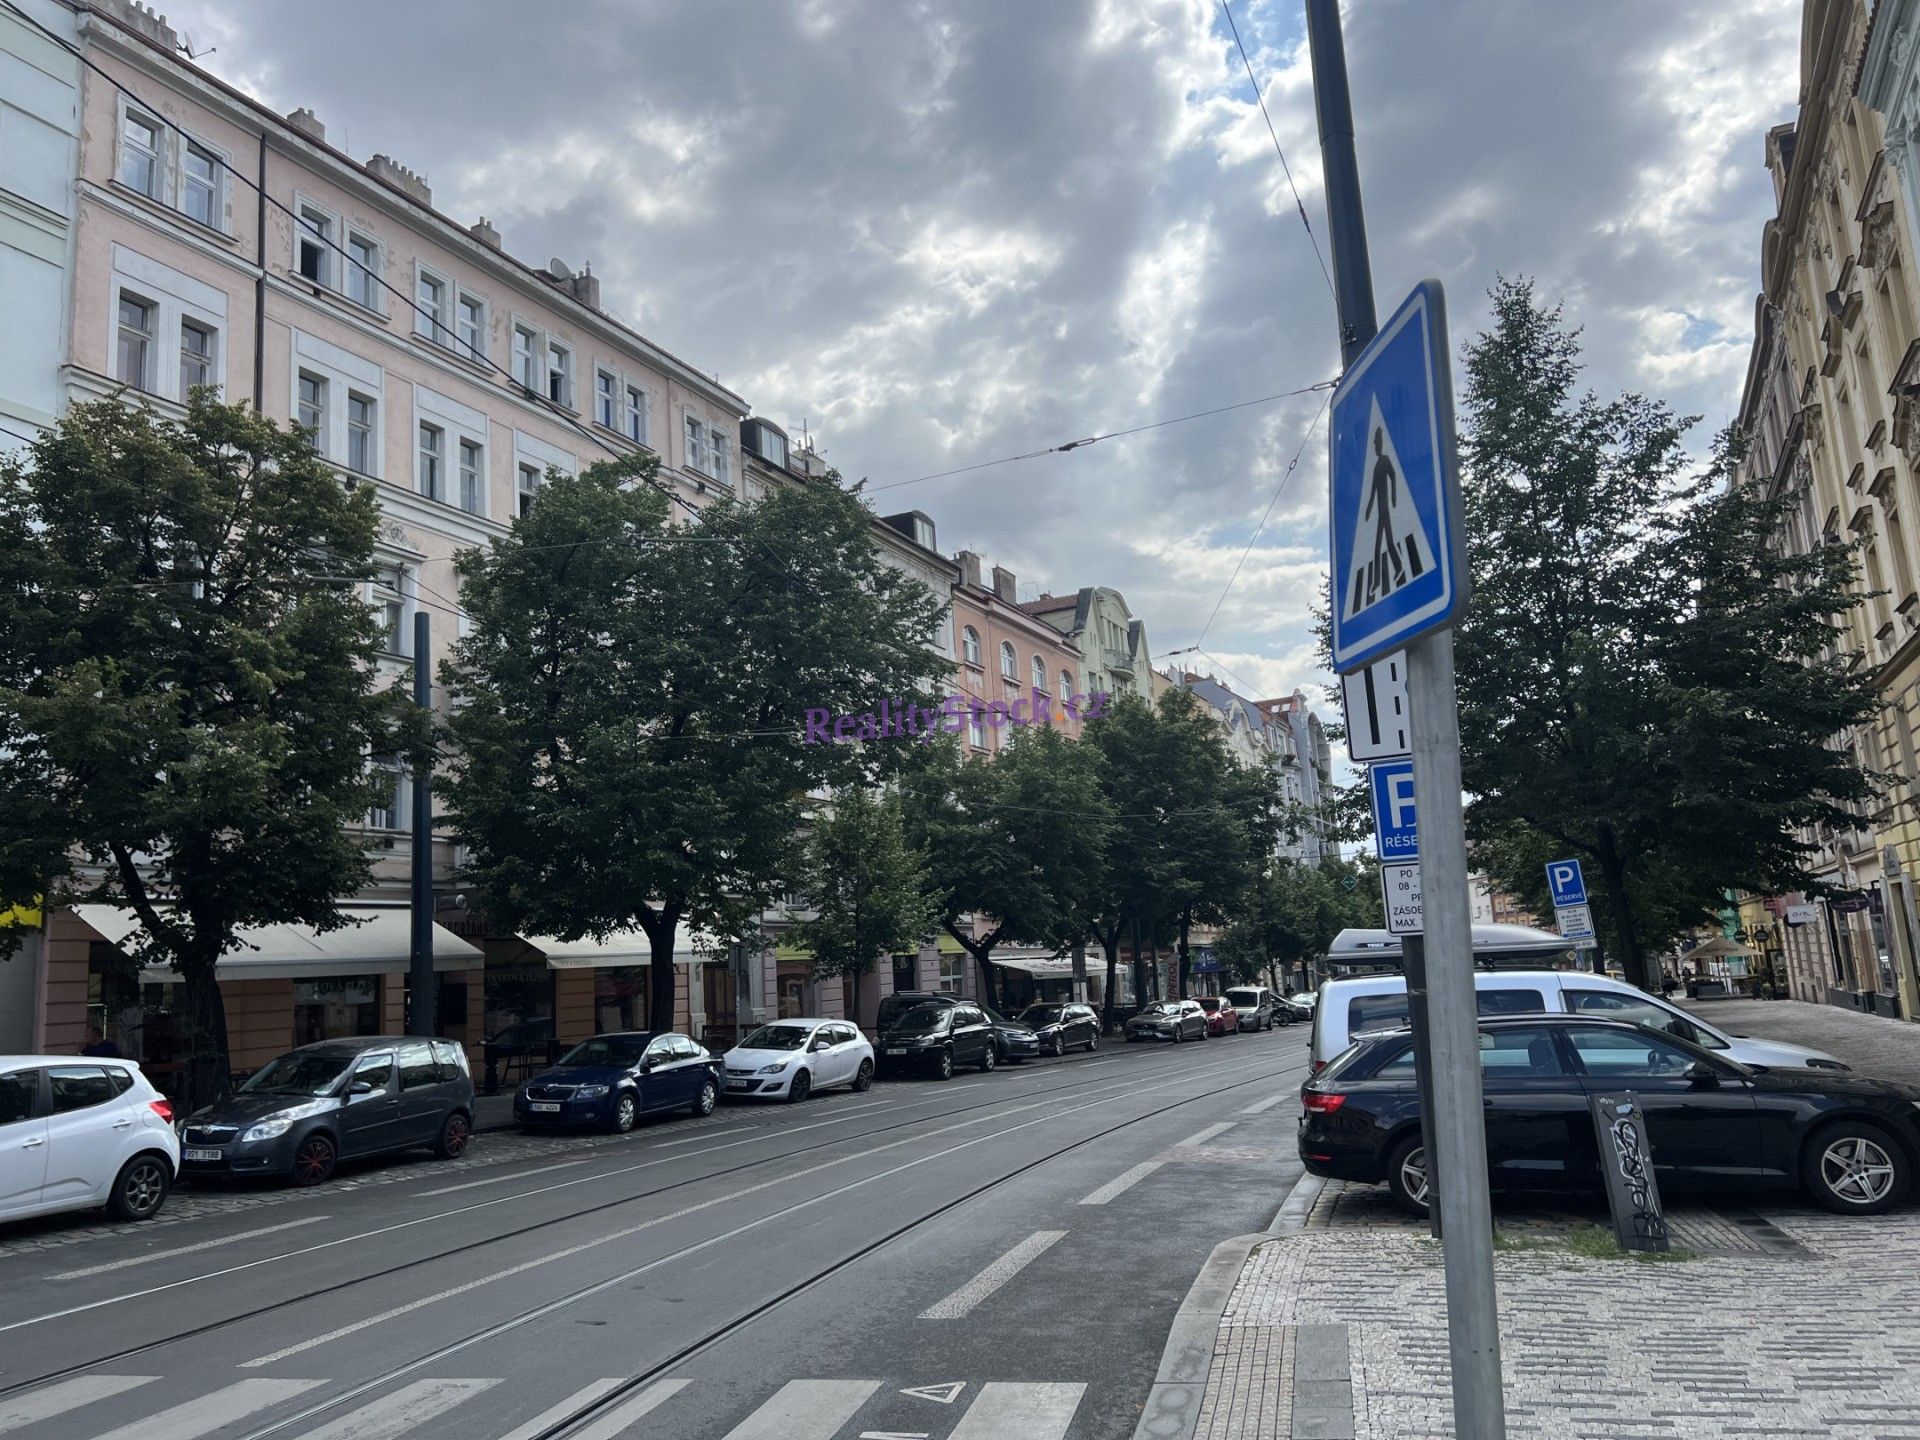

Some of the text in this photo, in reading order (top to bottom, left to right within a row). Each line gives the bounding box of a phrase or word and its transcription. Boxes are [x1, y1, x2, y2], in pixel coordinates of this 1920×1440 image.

[1400, 869, 1412, 878] PO
[1554, 866, 1574, 893] P
[1398, 882, 1410, 891] 08
[1395, 919, 1418, 928] MAX.
